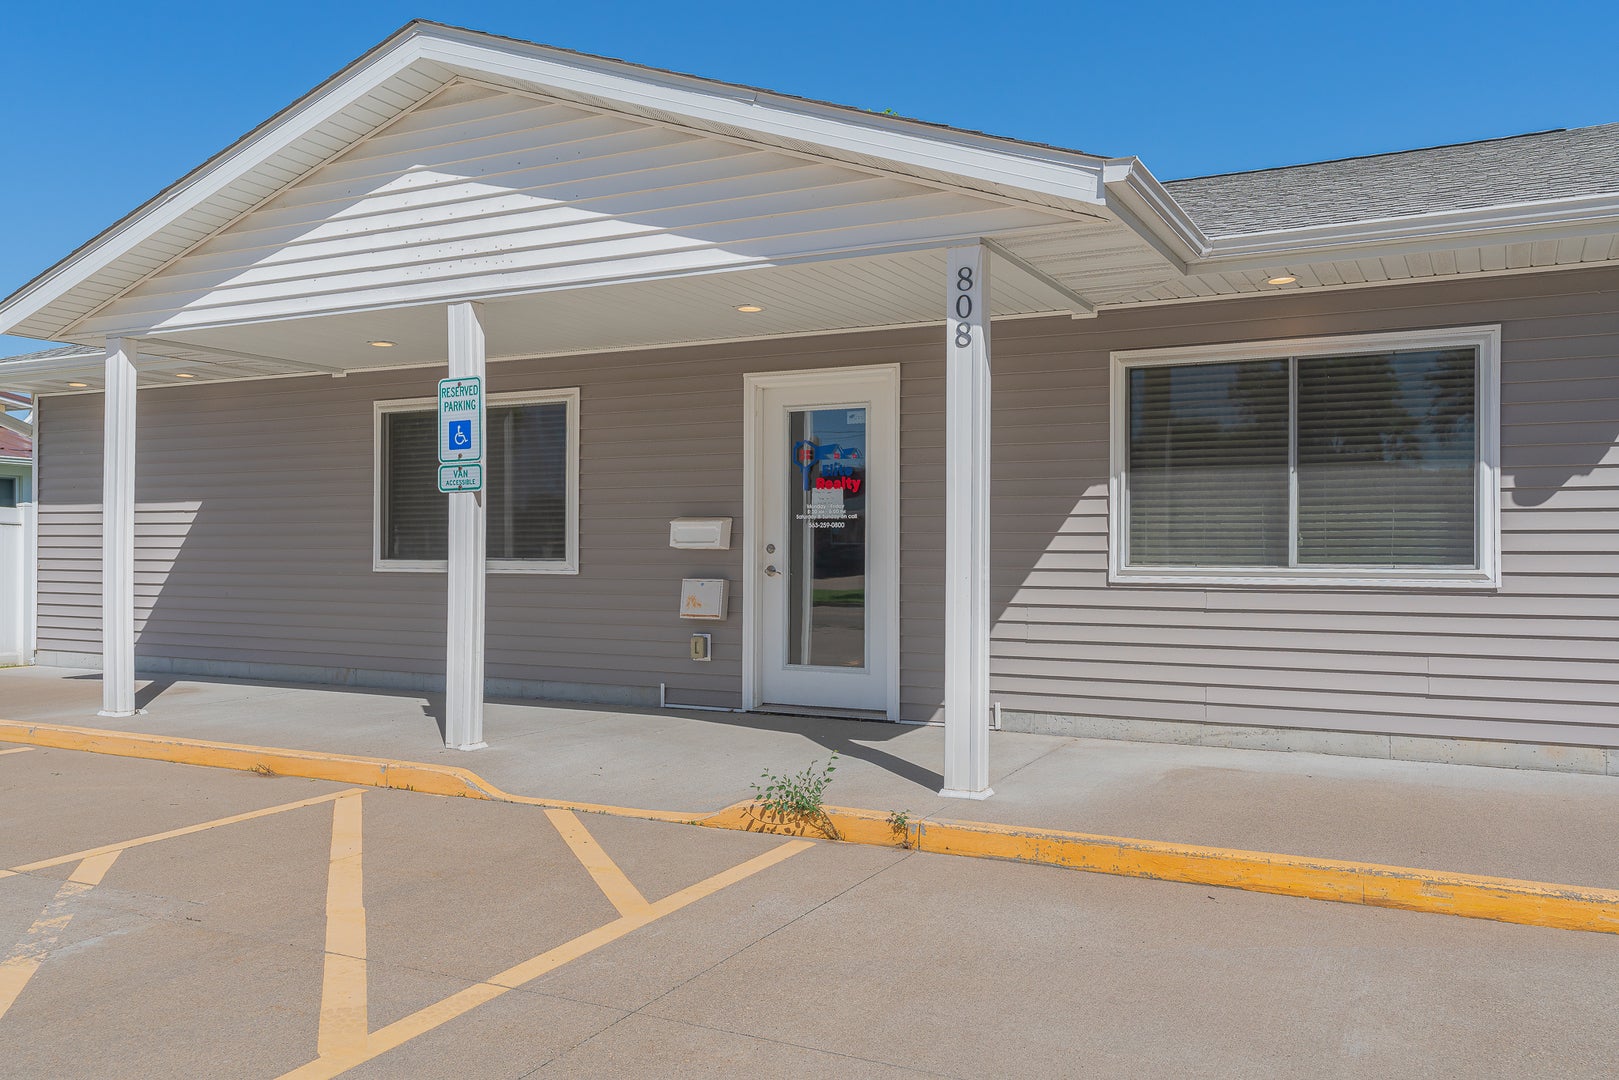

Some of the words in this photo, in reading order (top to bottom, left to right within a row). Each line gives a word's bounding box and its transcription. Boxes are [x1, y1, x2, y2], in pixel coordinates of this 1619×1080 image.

[955, 266, 973, 349] 808
[441, 384, 479, 399] RESERVED
[443, 399, 477, 412] PARKING
[453, 469, 469, 478] VAN
[822, 462, 853, 477] Elite
[445, 478, 476, 486] ACCESSIBLE
[815, 475, 861, 493] Realty
